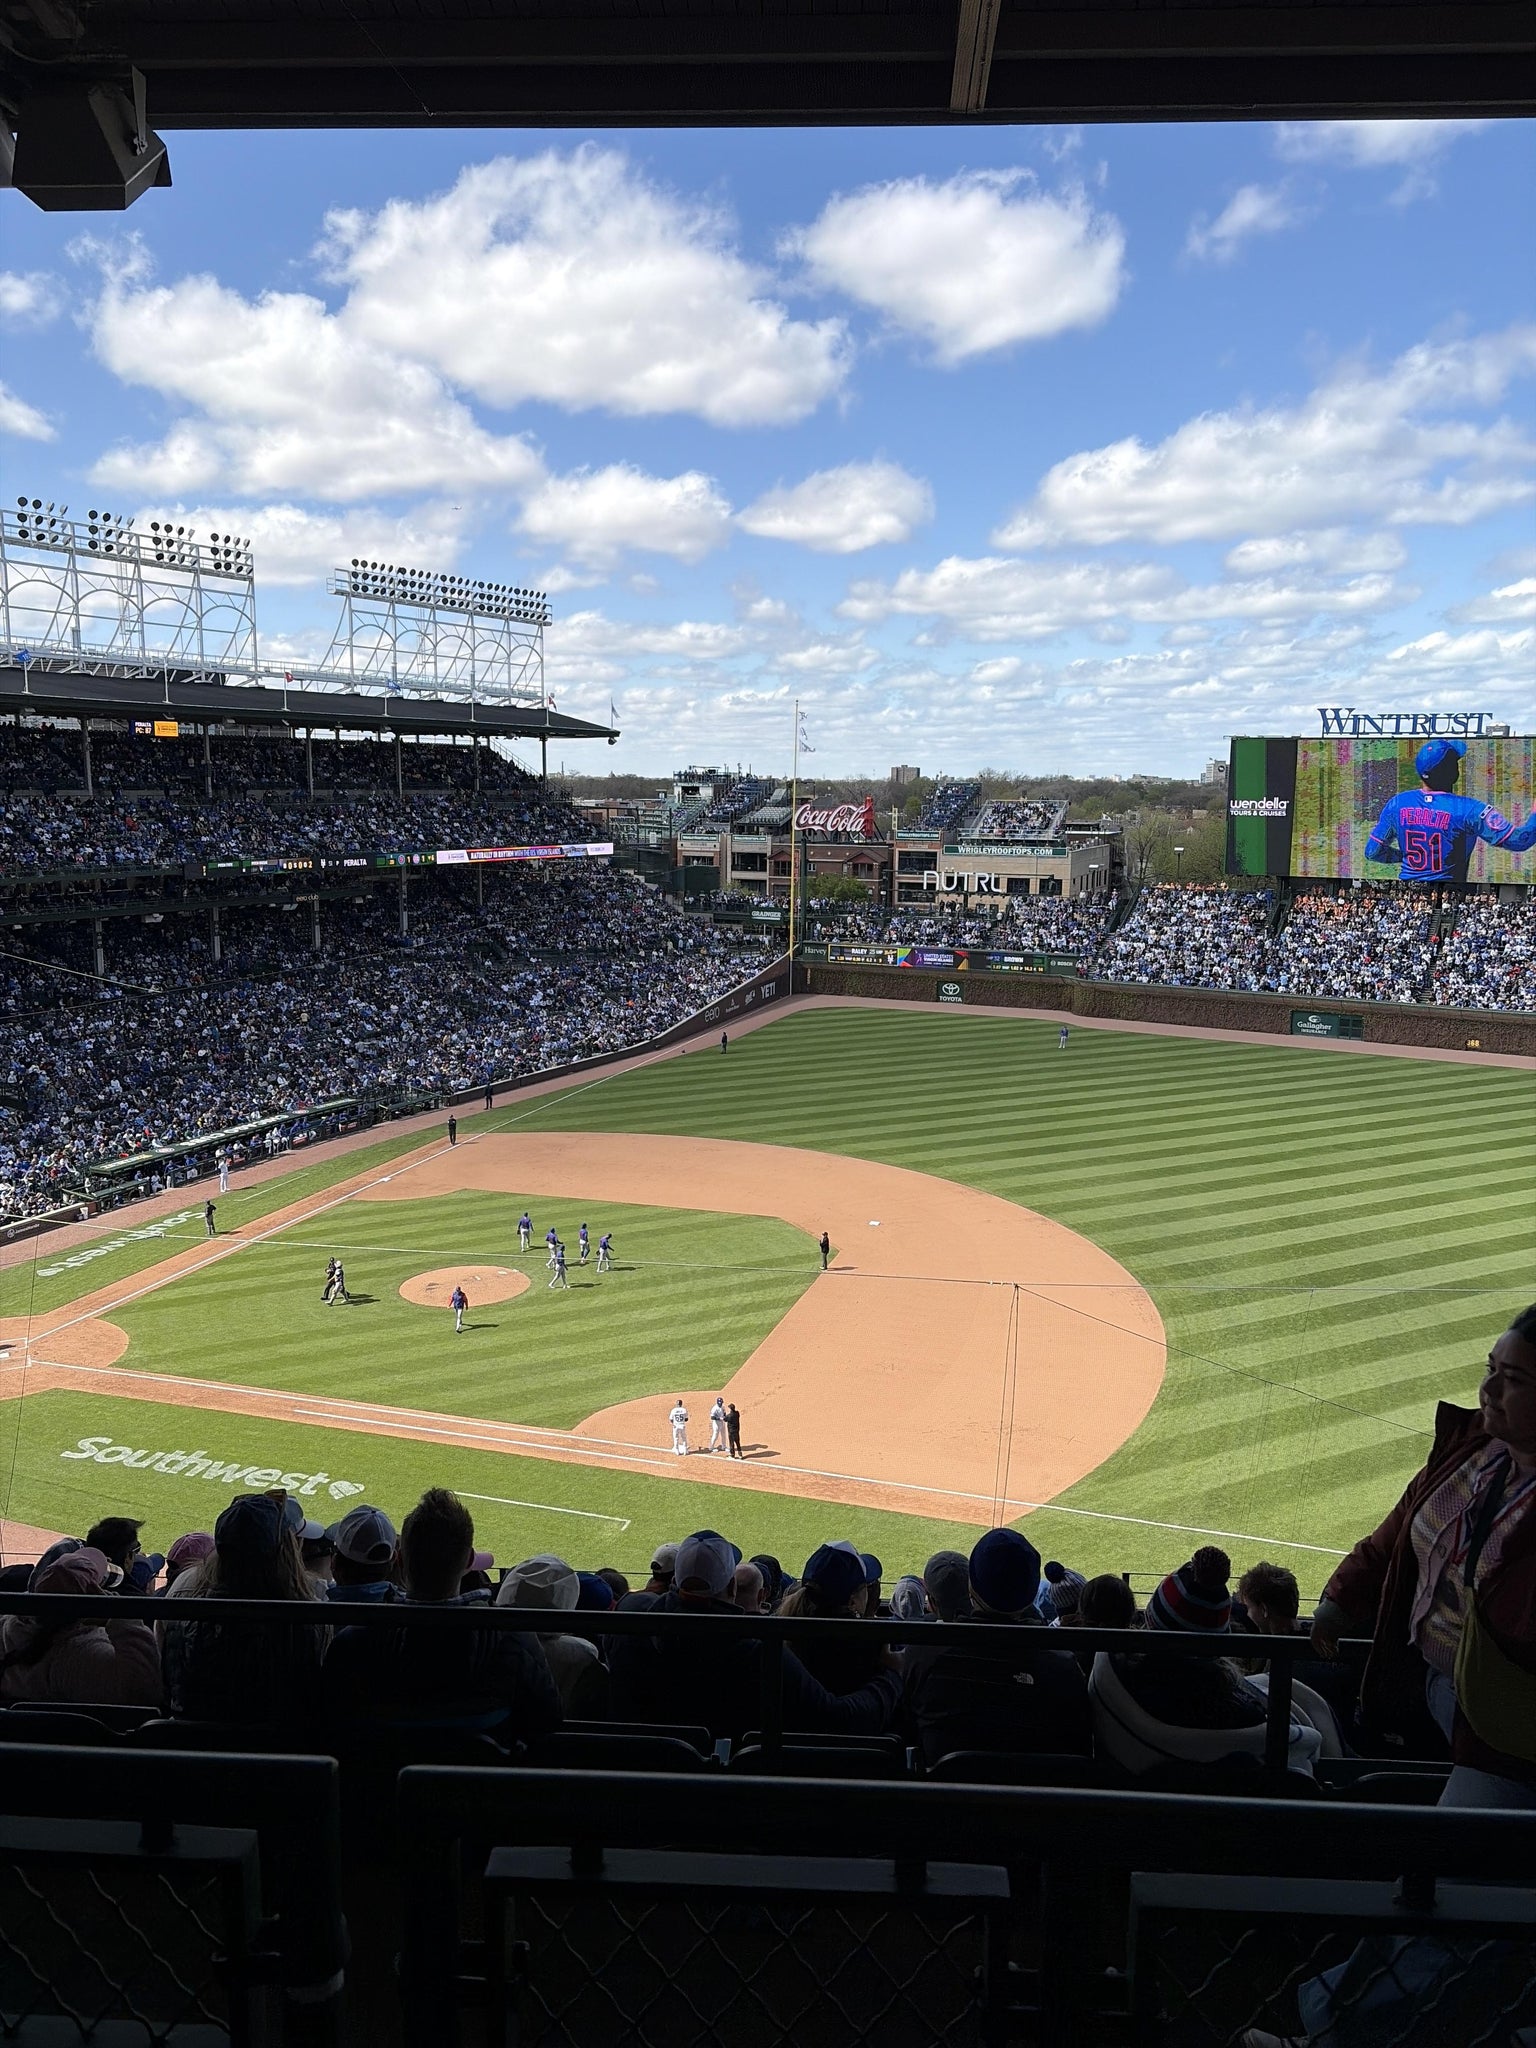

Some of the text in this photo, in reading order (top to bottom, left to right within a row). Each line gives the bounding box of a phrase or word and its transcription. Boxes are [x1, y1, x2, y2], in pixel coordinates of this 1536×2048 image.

[1317, 707, 1493, 736] WINTRUST
[1230, 797, 1287, 809] wendella
[794, 803, 869, 832] Coca-Cola
[1399, 807, 1451, 830] PERALTA
[957, 846, 1053, 855] WRIGLEYROOFTOPS.COM
[1405, 830, 1442, 872] 51
[344, 858, 368, 867] PERALTA
[804, 947, 827, 956] Harvey
[760, 982, 776, 999] YETI
[1296, 1020, 1332, 1031] Gallagher
[60, 1436, 330, 1496] Southwest
